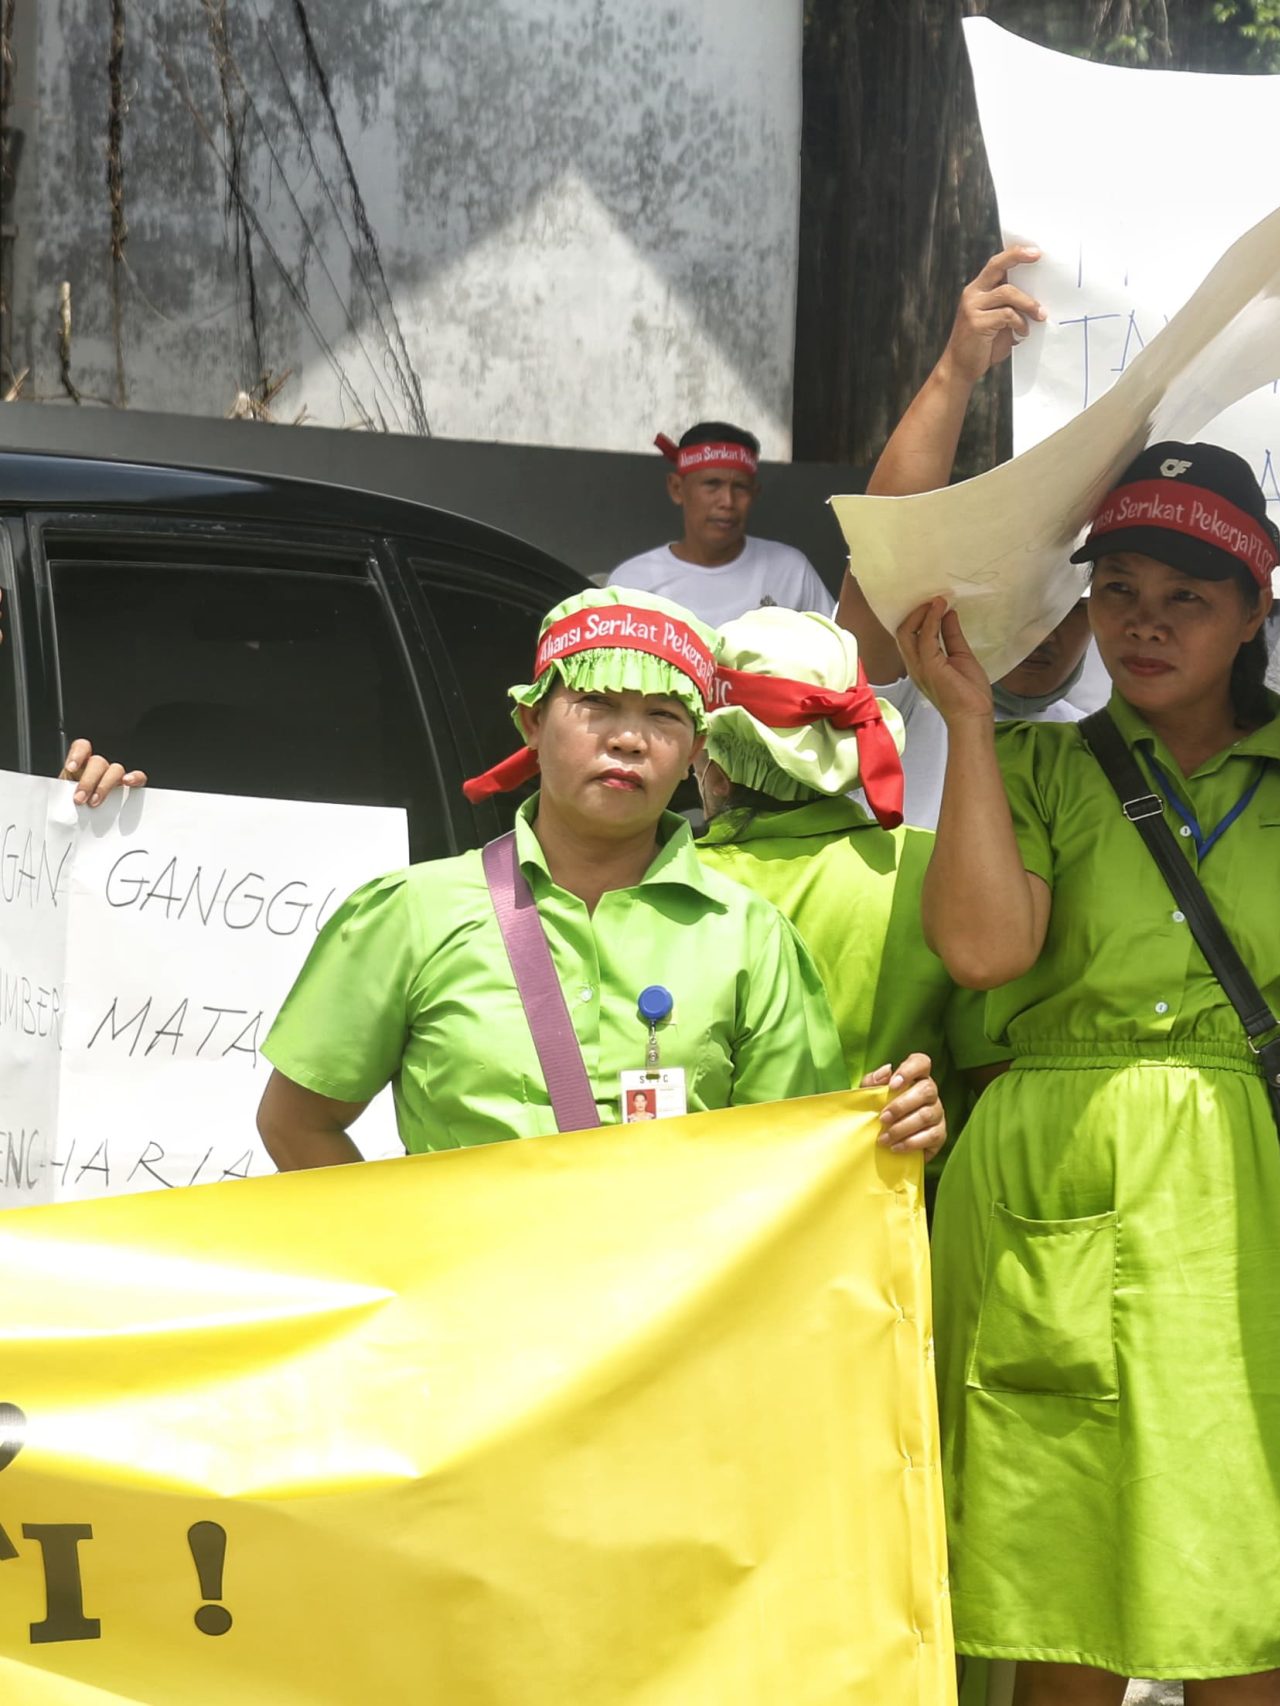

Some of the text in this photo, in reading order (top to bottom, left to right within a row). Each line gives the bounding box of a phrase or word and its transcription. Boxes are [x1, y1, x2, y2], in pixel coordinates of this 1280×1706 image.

[1116, 494, 1185, 524] Serikat
[538, 627, 580, 665] Aliansi
[584, 613, 658, 643] Serikat
[0, 970, 265, 1070] MBER MATA
